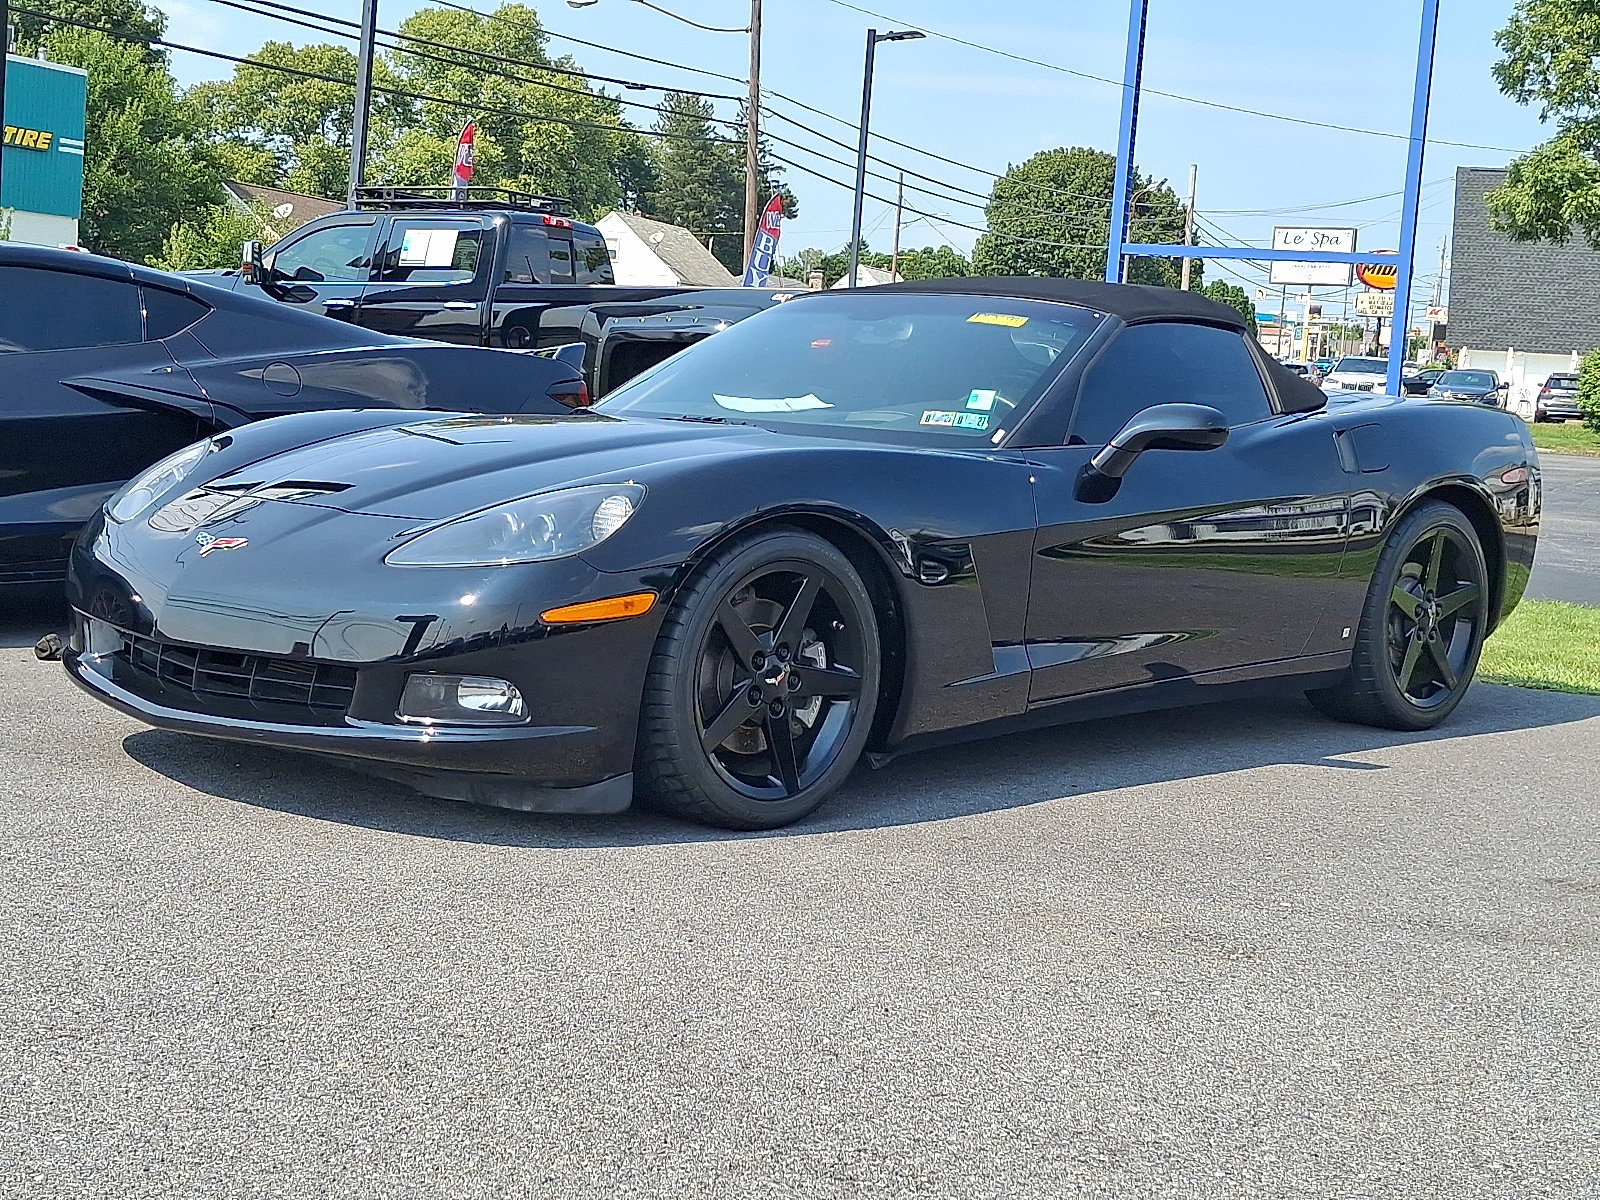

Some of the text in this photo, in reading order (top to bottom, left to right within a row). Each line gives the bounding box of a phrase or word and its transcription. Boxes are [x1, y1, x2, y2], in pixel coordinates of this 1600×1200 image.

[3, 125, 53, 149] TIRE
[1310, 231, 1342, 248] Spa
[749, 231, 775, 288] BUY
